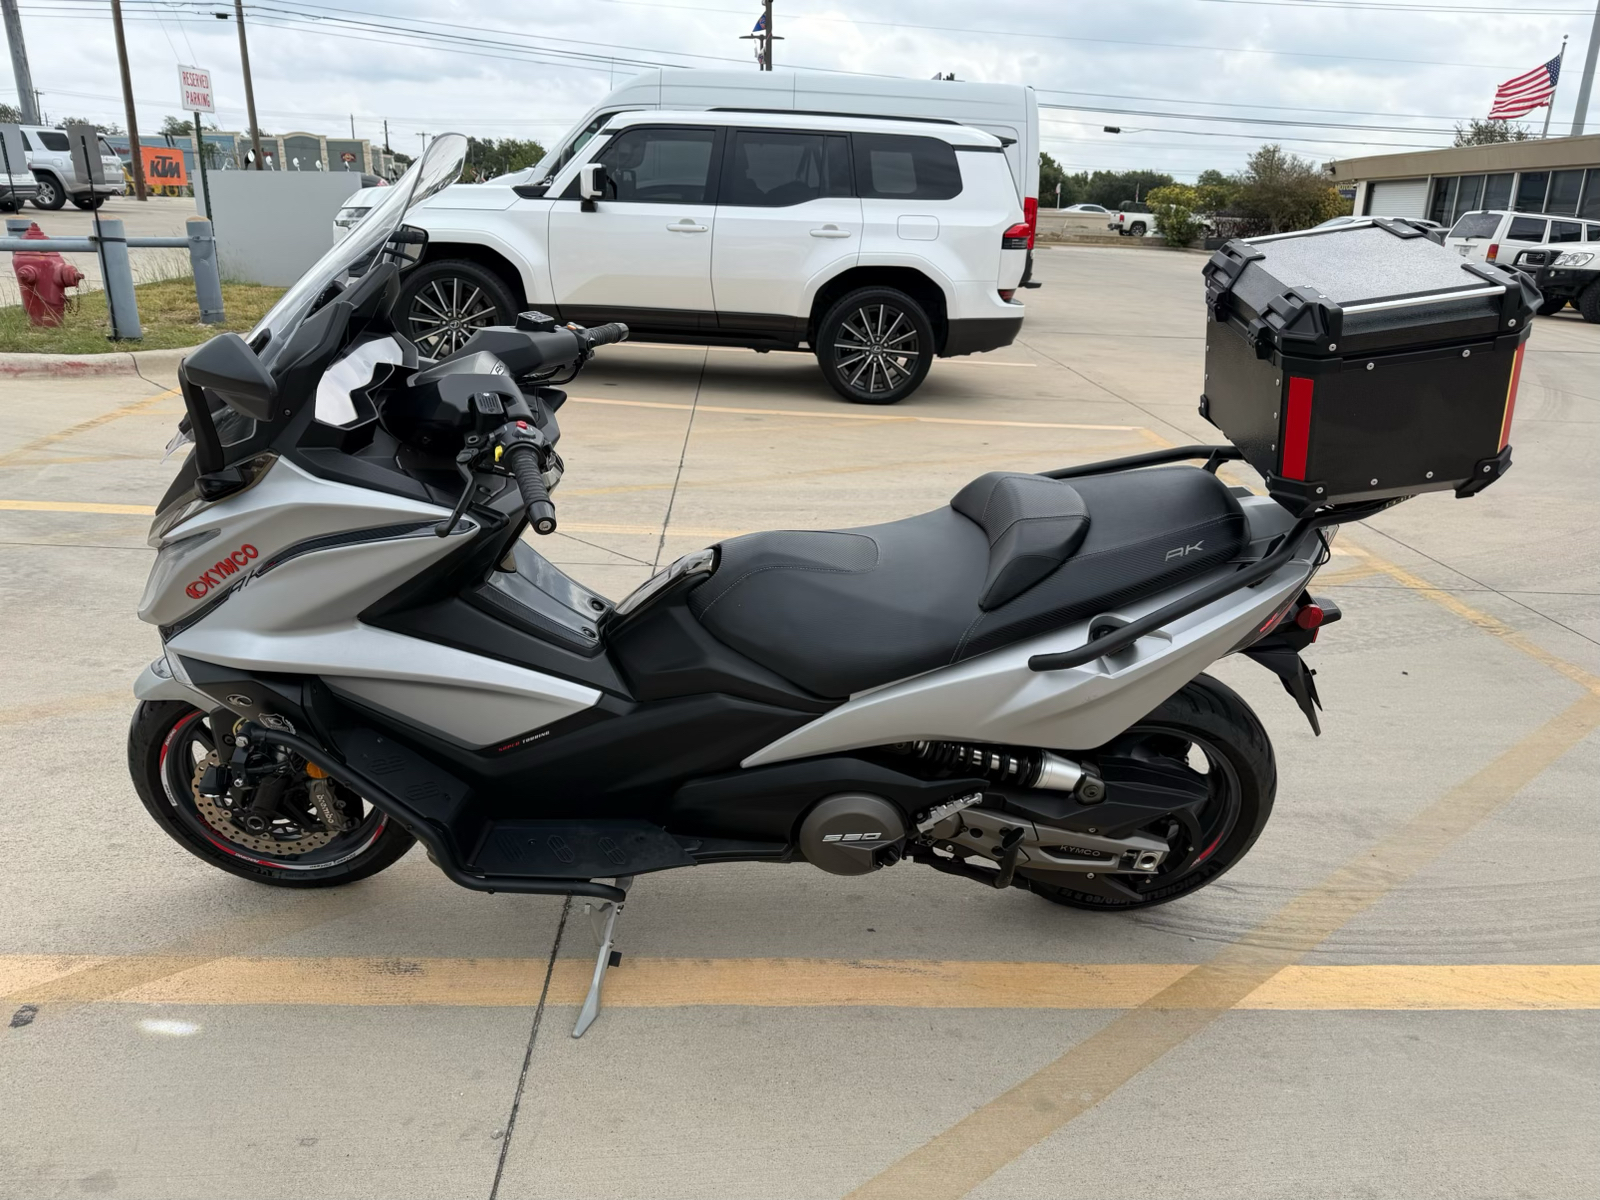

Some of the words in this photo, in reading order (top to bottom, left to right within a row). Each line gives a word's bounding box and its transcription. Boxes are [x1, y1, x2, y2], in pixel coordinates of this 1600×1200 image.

[182, 71, 209, 89] RESERVED
[185, 90, 211, 107] PARKING
[150, 155, 181, 178] KTM
[1165, 540, 1204, 561] AK
[199, 544, 258, 589] KYMCO
[316, 794, 334, 824] brembo
[822, 832, 882, 842] 550
[1060, 845, 1101, 856] KYMCO
